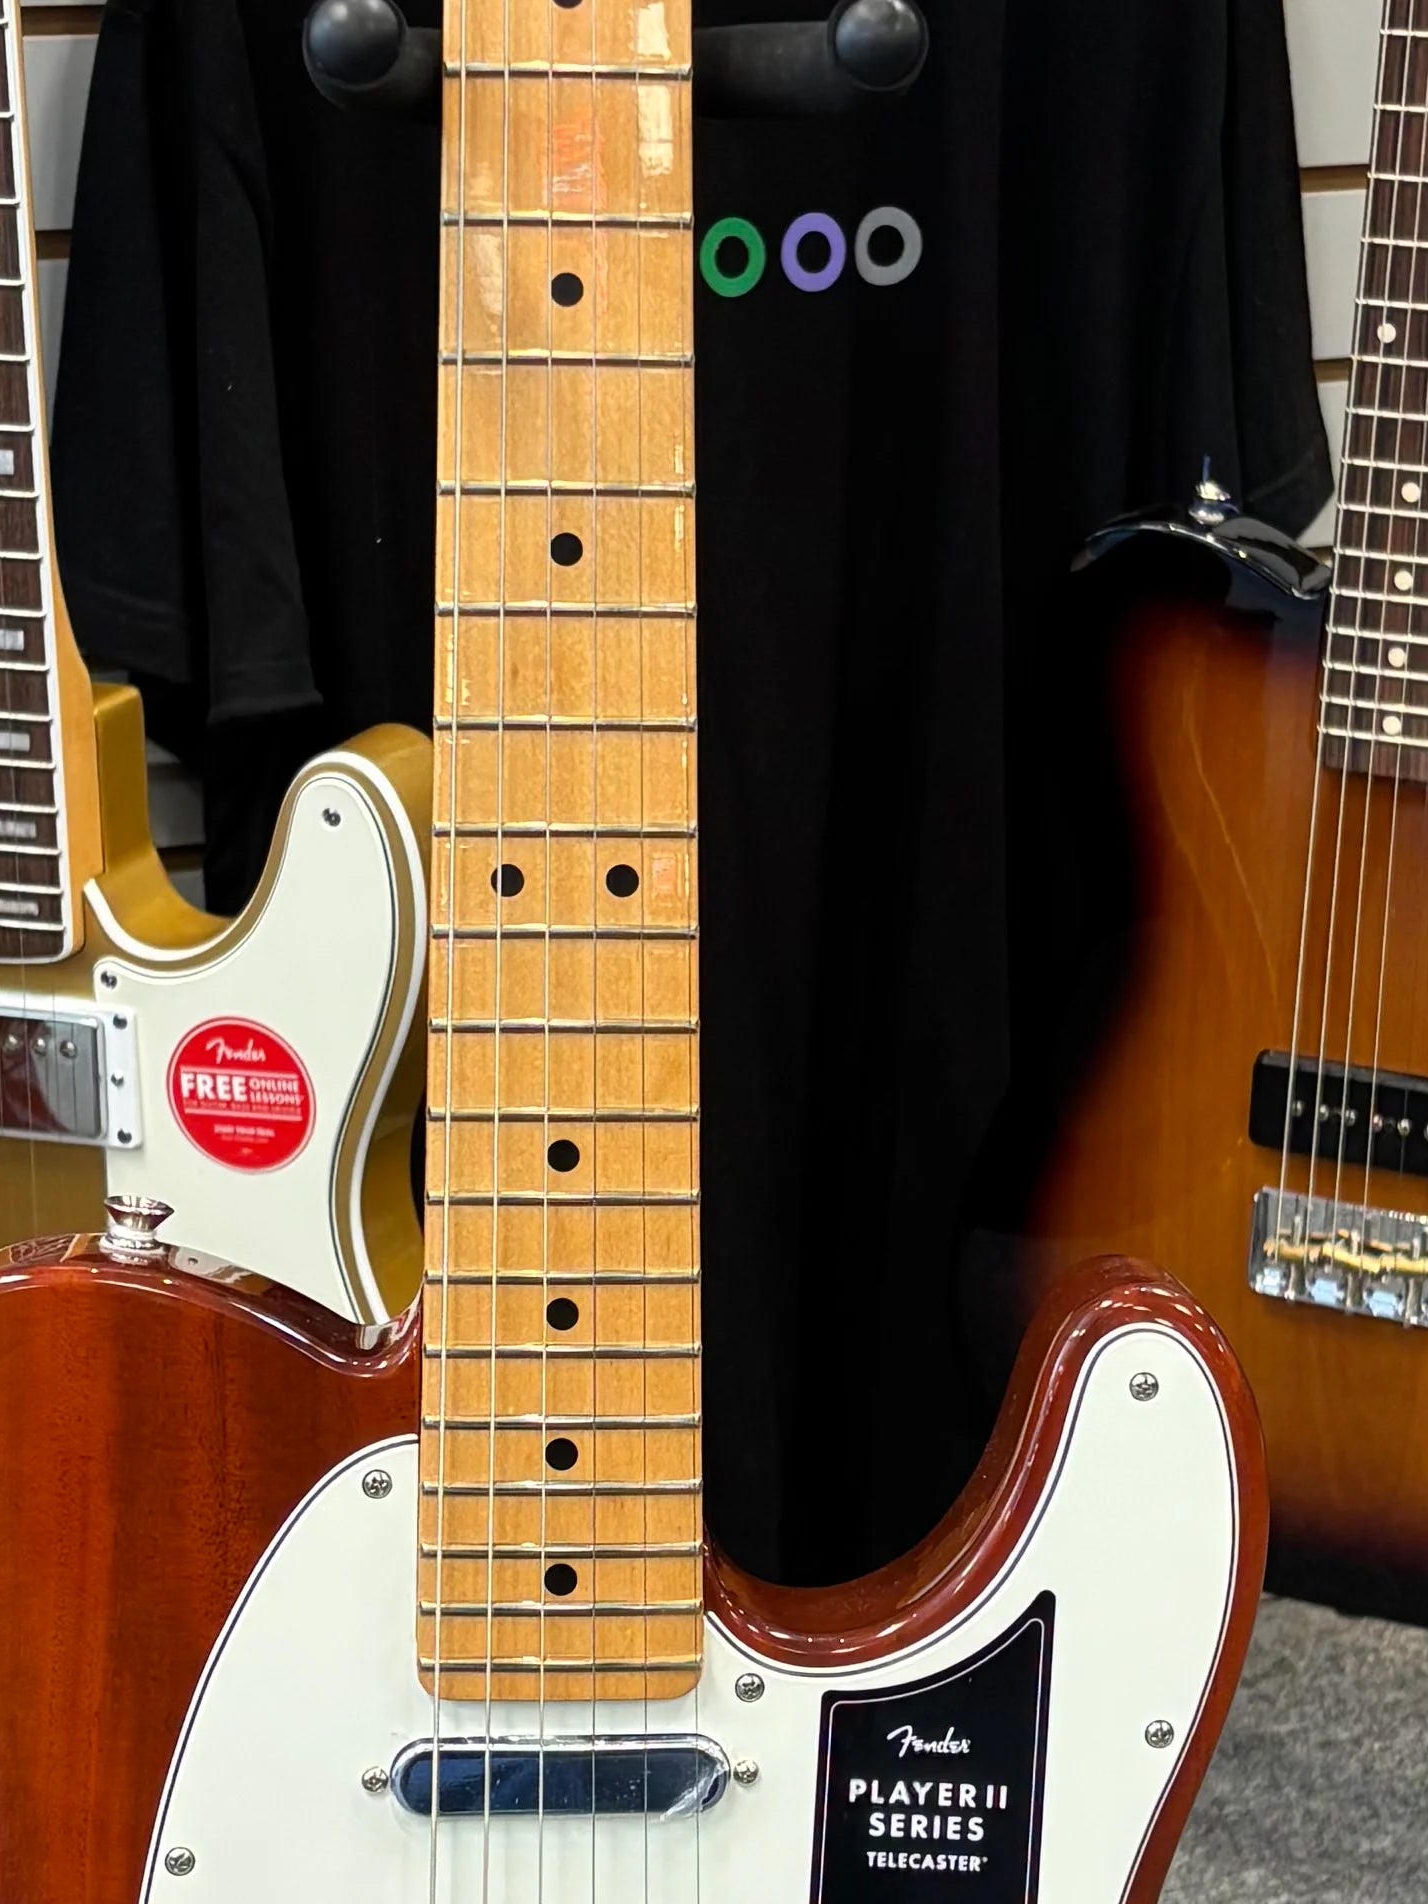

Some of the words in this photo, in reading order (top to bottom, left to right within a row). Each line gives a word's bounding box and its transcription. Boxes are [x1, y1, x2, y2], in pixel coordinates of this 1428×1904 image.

[205, 1036, 267, 1065] Fender
[180, 1071, 248, 1103] FREE
[249, 1077, 299, 1092] ONLINE
[886, 1724, 971, 1758] Fender
[848, 1778, 978, 1809] PLAYER
[985, 1784, 1009, 1810] II
[868, 1812, 985, 1842] SERIES
